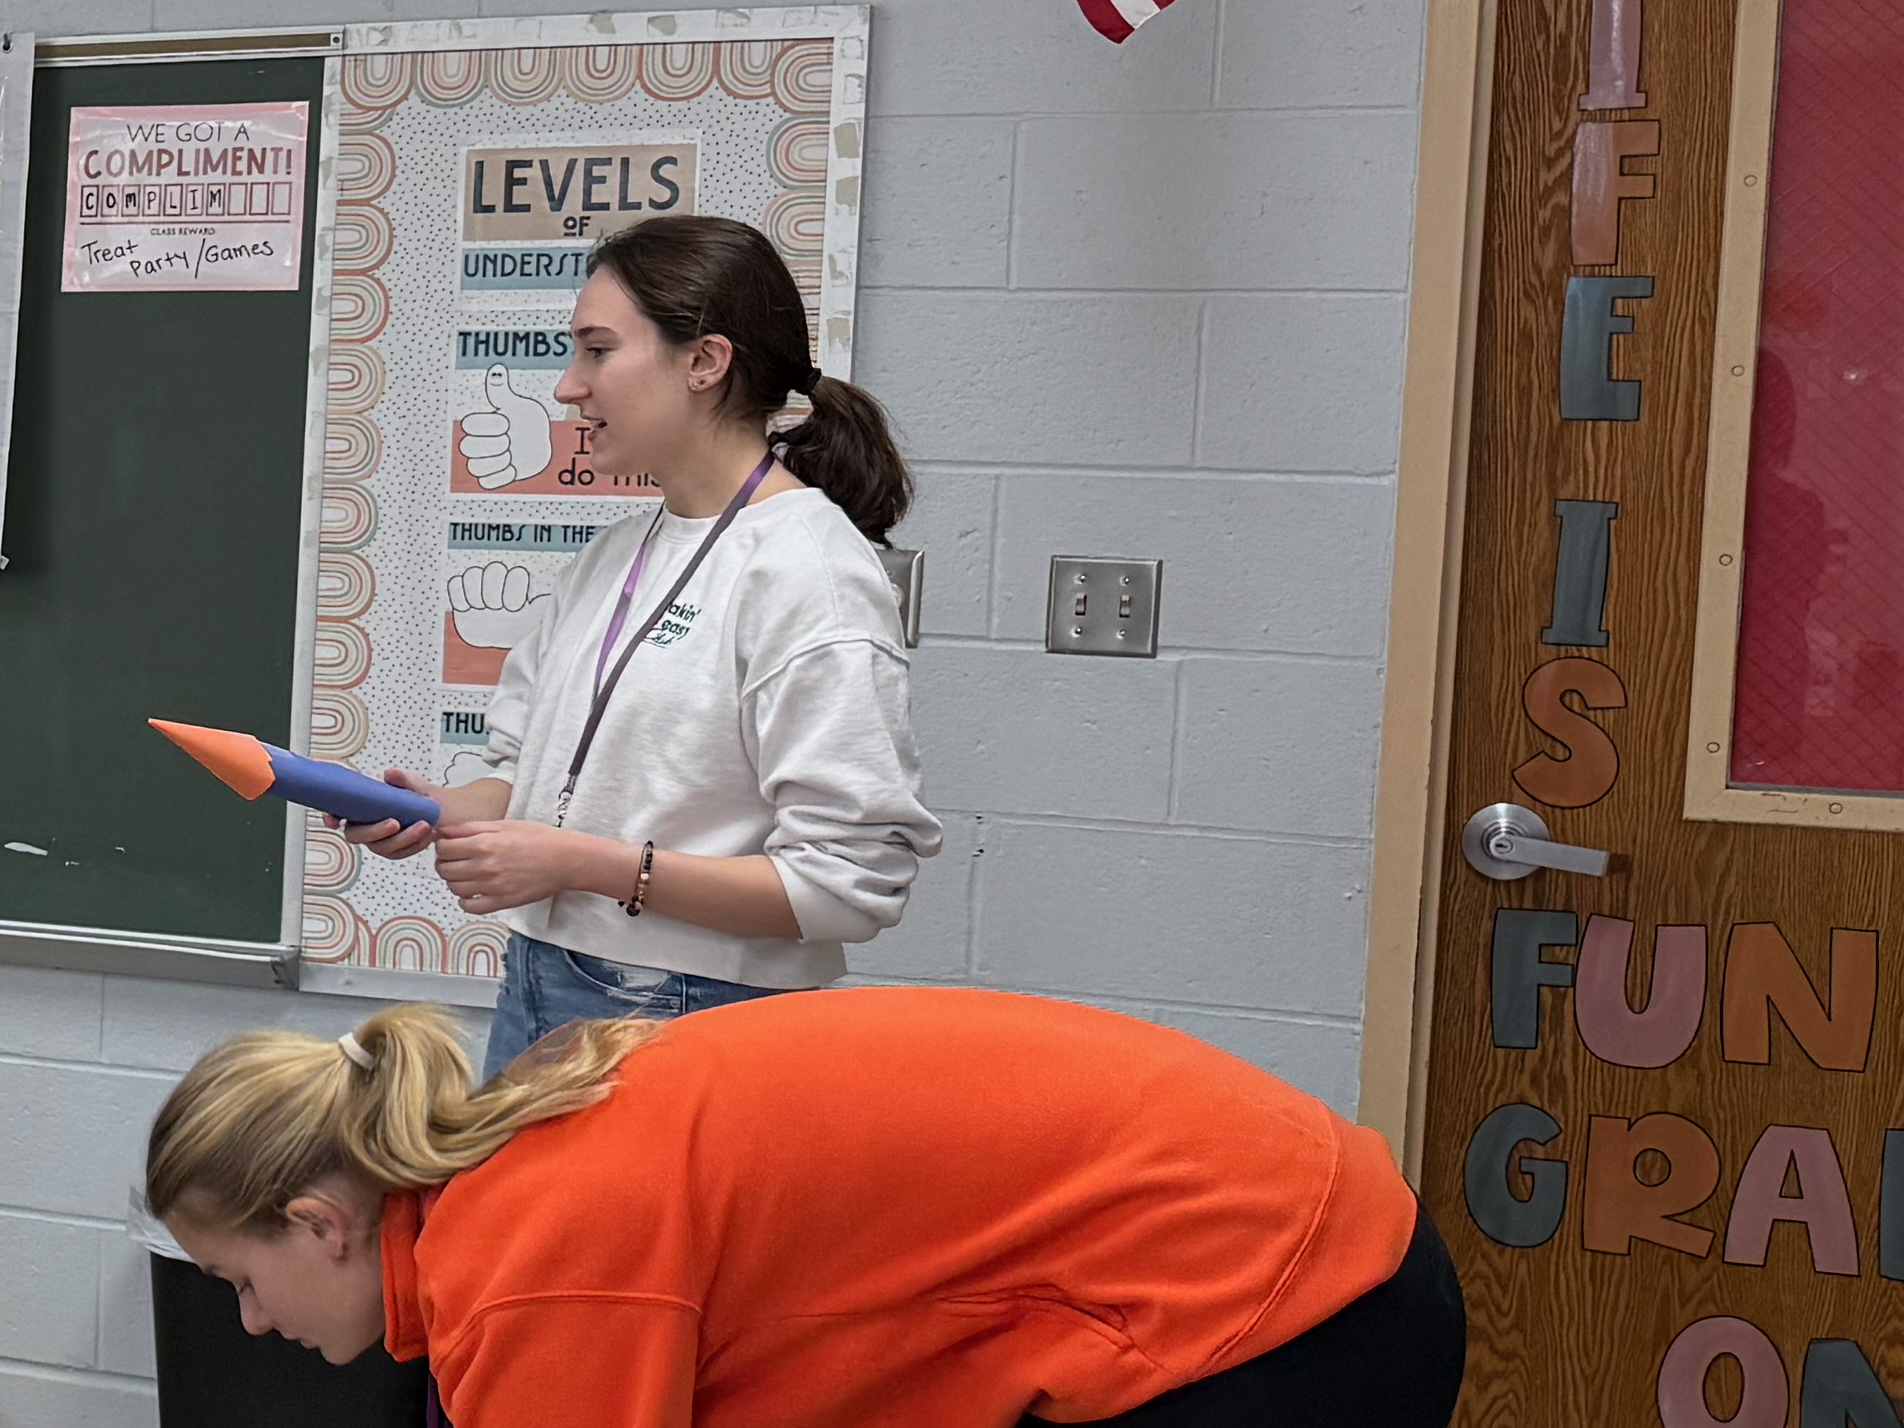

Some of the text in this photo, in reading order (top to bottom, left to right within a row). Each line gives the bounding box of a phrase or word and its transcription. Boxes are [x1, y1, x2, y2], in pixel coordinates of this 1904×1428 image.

[127, 122, 249, 143] WE GOT A
[84, 147, 292, 179] COMPLIMENT!
[473, 156, 680, 215] LEVELS
[150, 228, 215, 236] CLASS REWARD
[563, 216, 591, 237] OF
[82, 239, 139, 265] Treat
[459, 331, 568, 358] THUMBS
[574, 427, 591, 454] I
[558, 457, 593, 486] do
[450, 522, 596, 543] THUMBS IN THE
[1490, 908, 1879, 1073] FUN
[1463, 1102, 1904, 1282] GRA
